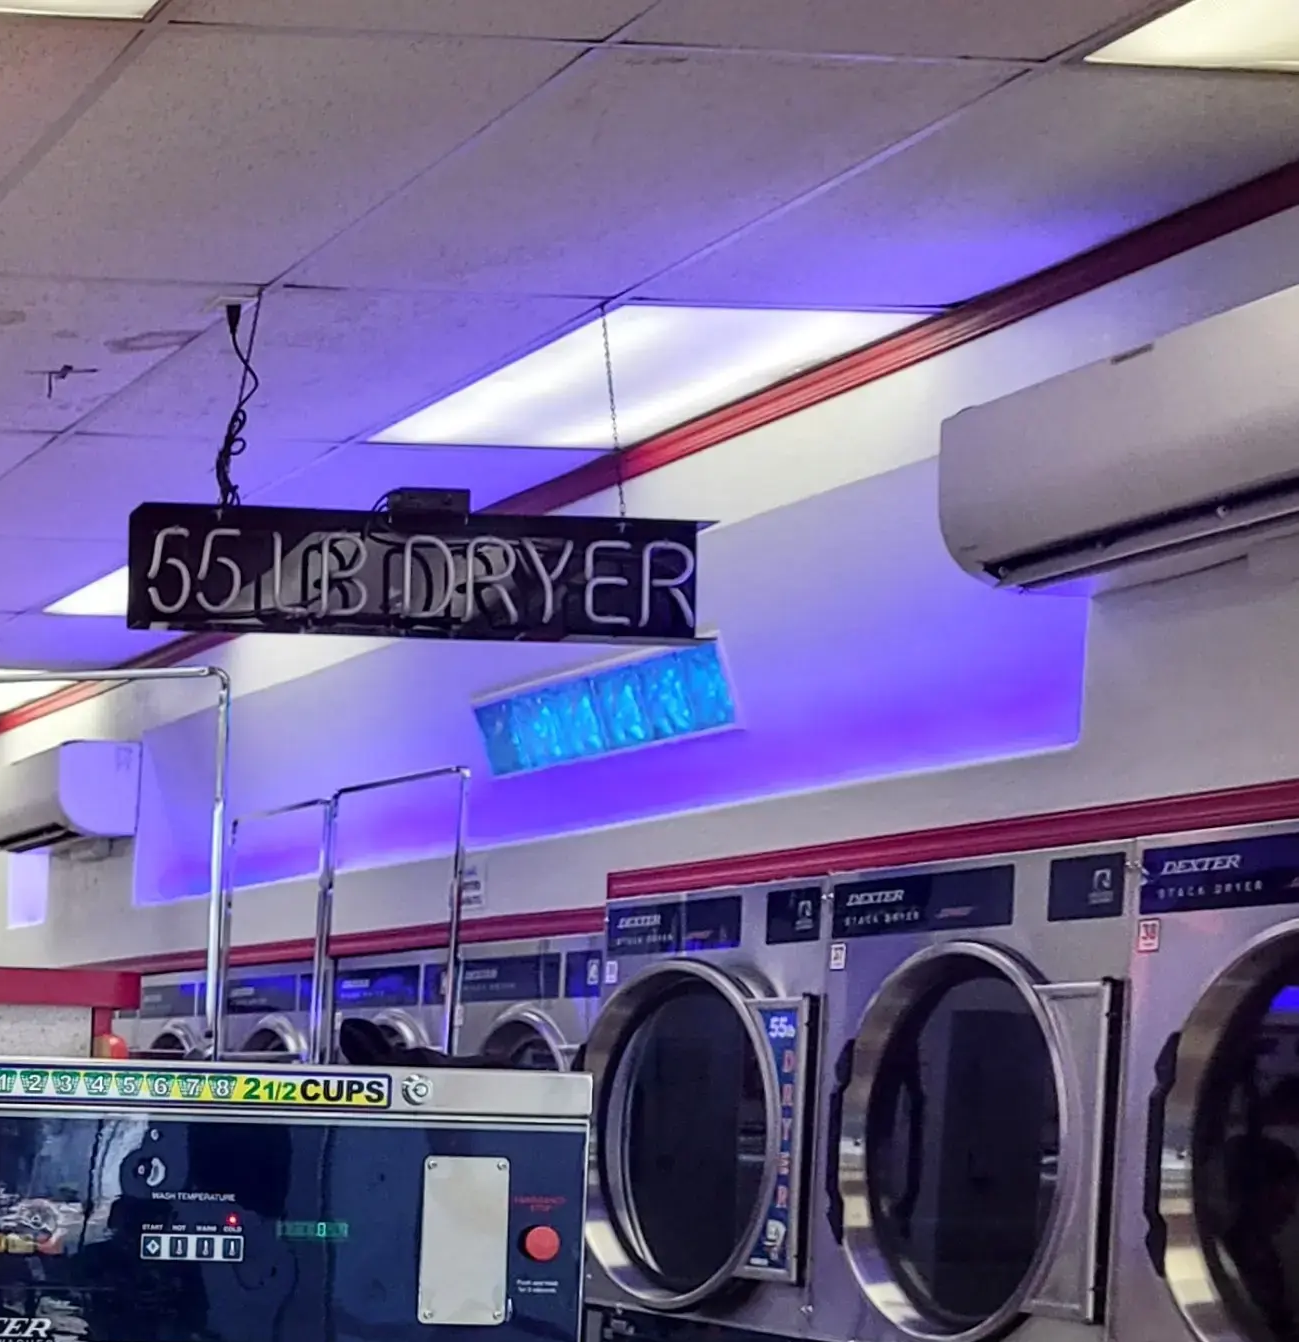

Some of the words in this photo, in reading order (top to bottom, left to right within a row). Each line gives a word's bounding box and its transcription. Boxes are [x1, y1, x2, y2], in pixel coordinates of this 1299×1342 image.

[148, 527, 243, 614] 55
[272, 529, 368, 617] LB
[401, 533, 696, 628] DRYER
[1161, 854, 1242, 876] DEXTER
[27, 1074, 42, 1091] 2
[60, 1075, 73, 1092] 3
[89, 1076, 105, 1094] 4
[122, 1077, 136, 1095] 5
[154, 1078, 168, 1096] 6
[185, 1078, 199, 1096] 7
[216, 1079, 231, 1097] 8
[300, 1079, 385, 1103] CUPS
[152, 1191, 177, 1200] WASH
[177, 1192, 236, 1202] TEMPERATURE
